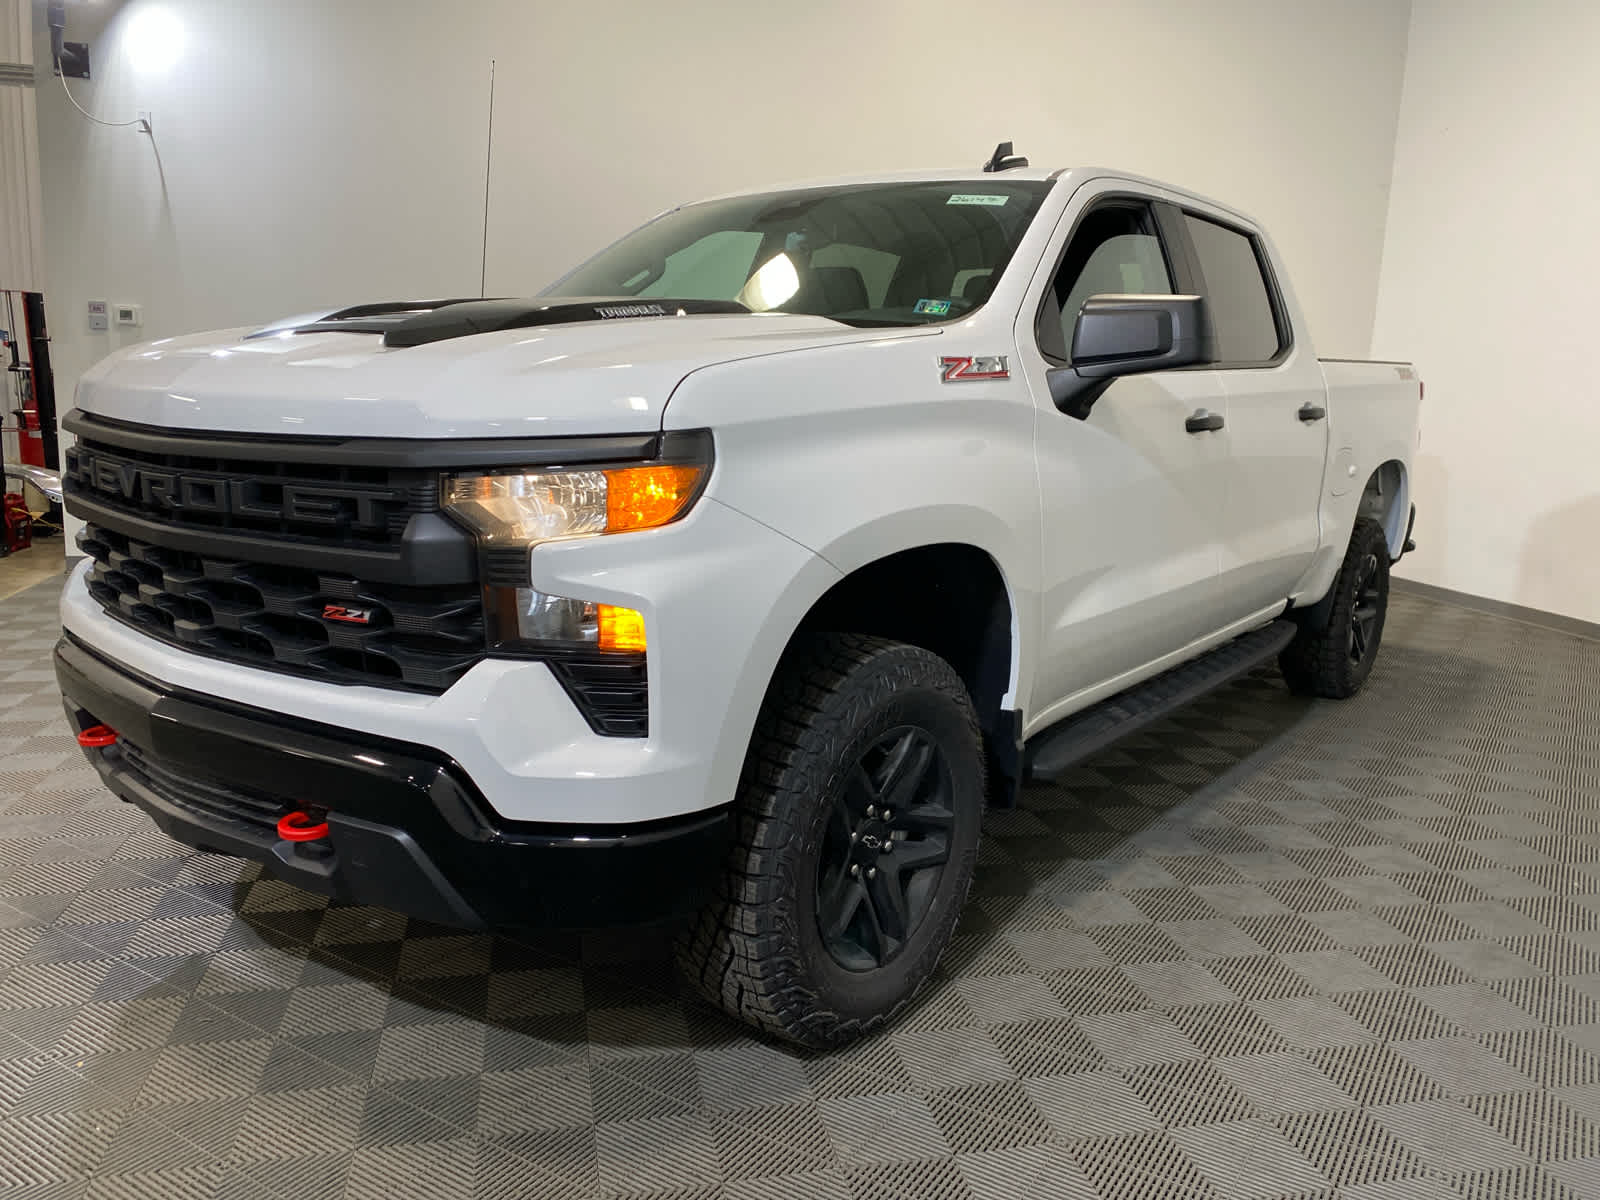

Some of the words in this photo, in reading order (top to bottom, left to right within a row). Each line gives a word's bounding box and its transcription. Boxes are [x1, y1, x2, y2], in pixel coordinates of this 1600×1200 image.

[938, 356, 1010, 383] Z71
[65, 449, 395, 526] CHEVROLET
[322, 604, 371, 624] Z71
